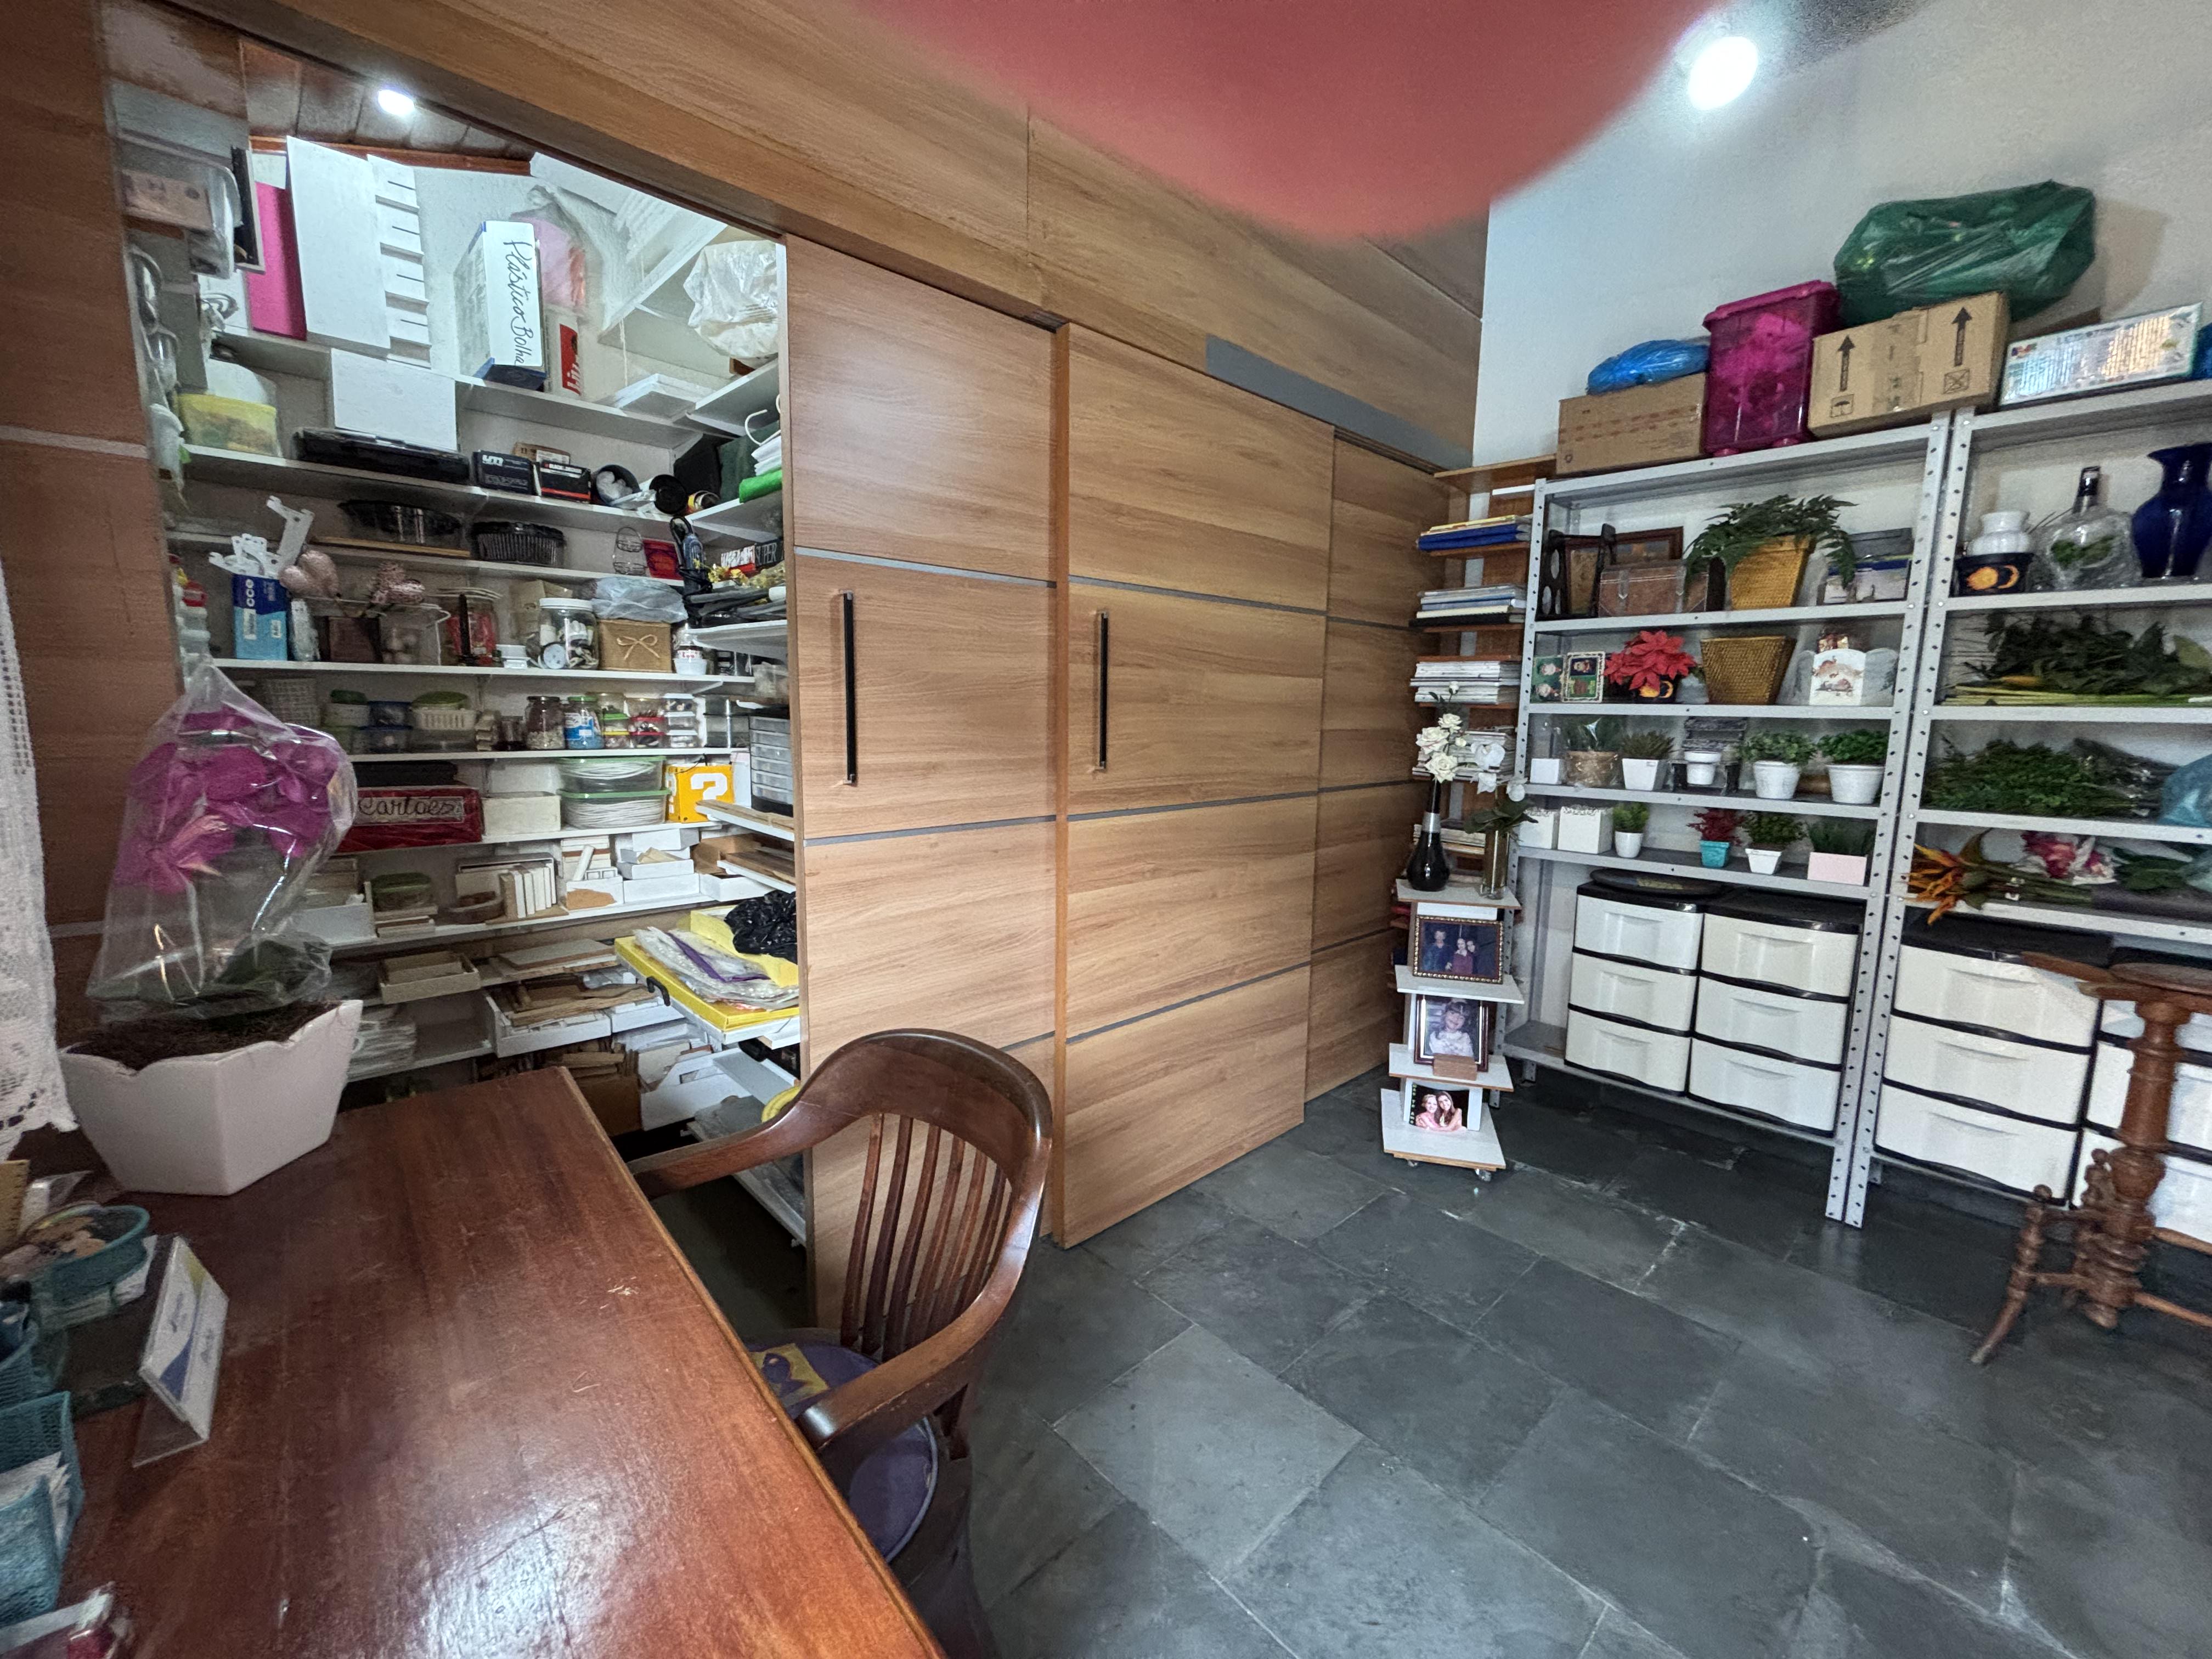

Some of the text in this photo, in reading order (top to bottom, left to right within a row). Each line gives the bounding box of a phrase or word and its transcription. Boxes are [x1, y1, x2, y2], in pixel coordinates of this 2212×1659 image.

[503, 240, 533, 366] Plástico Bolha
[358, 796, 454, 816] Cartões
